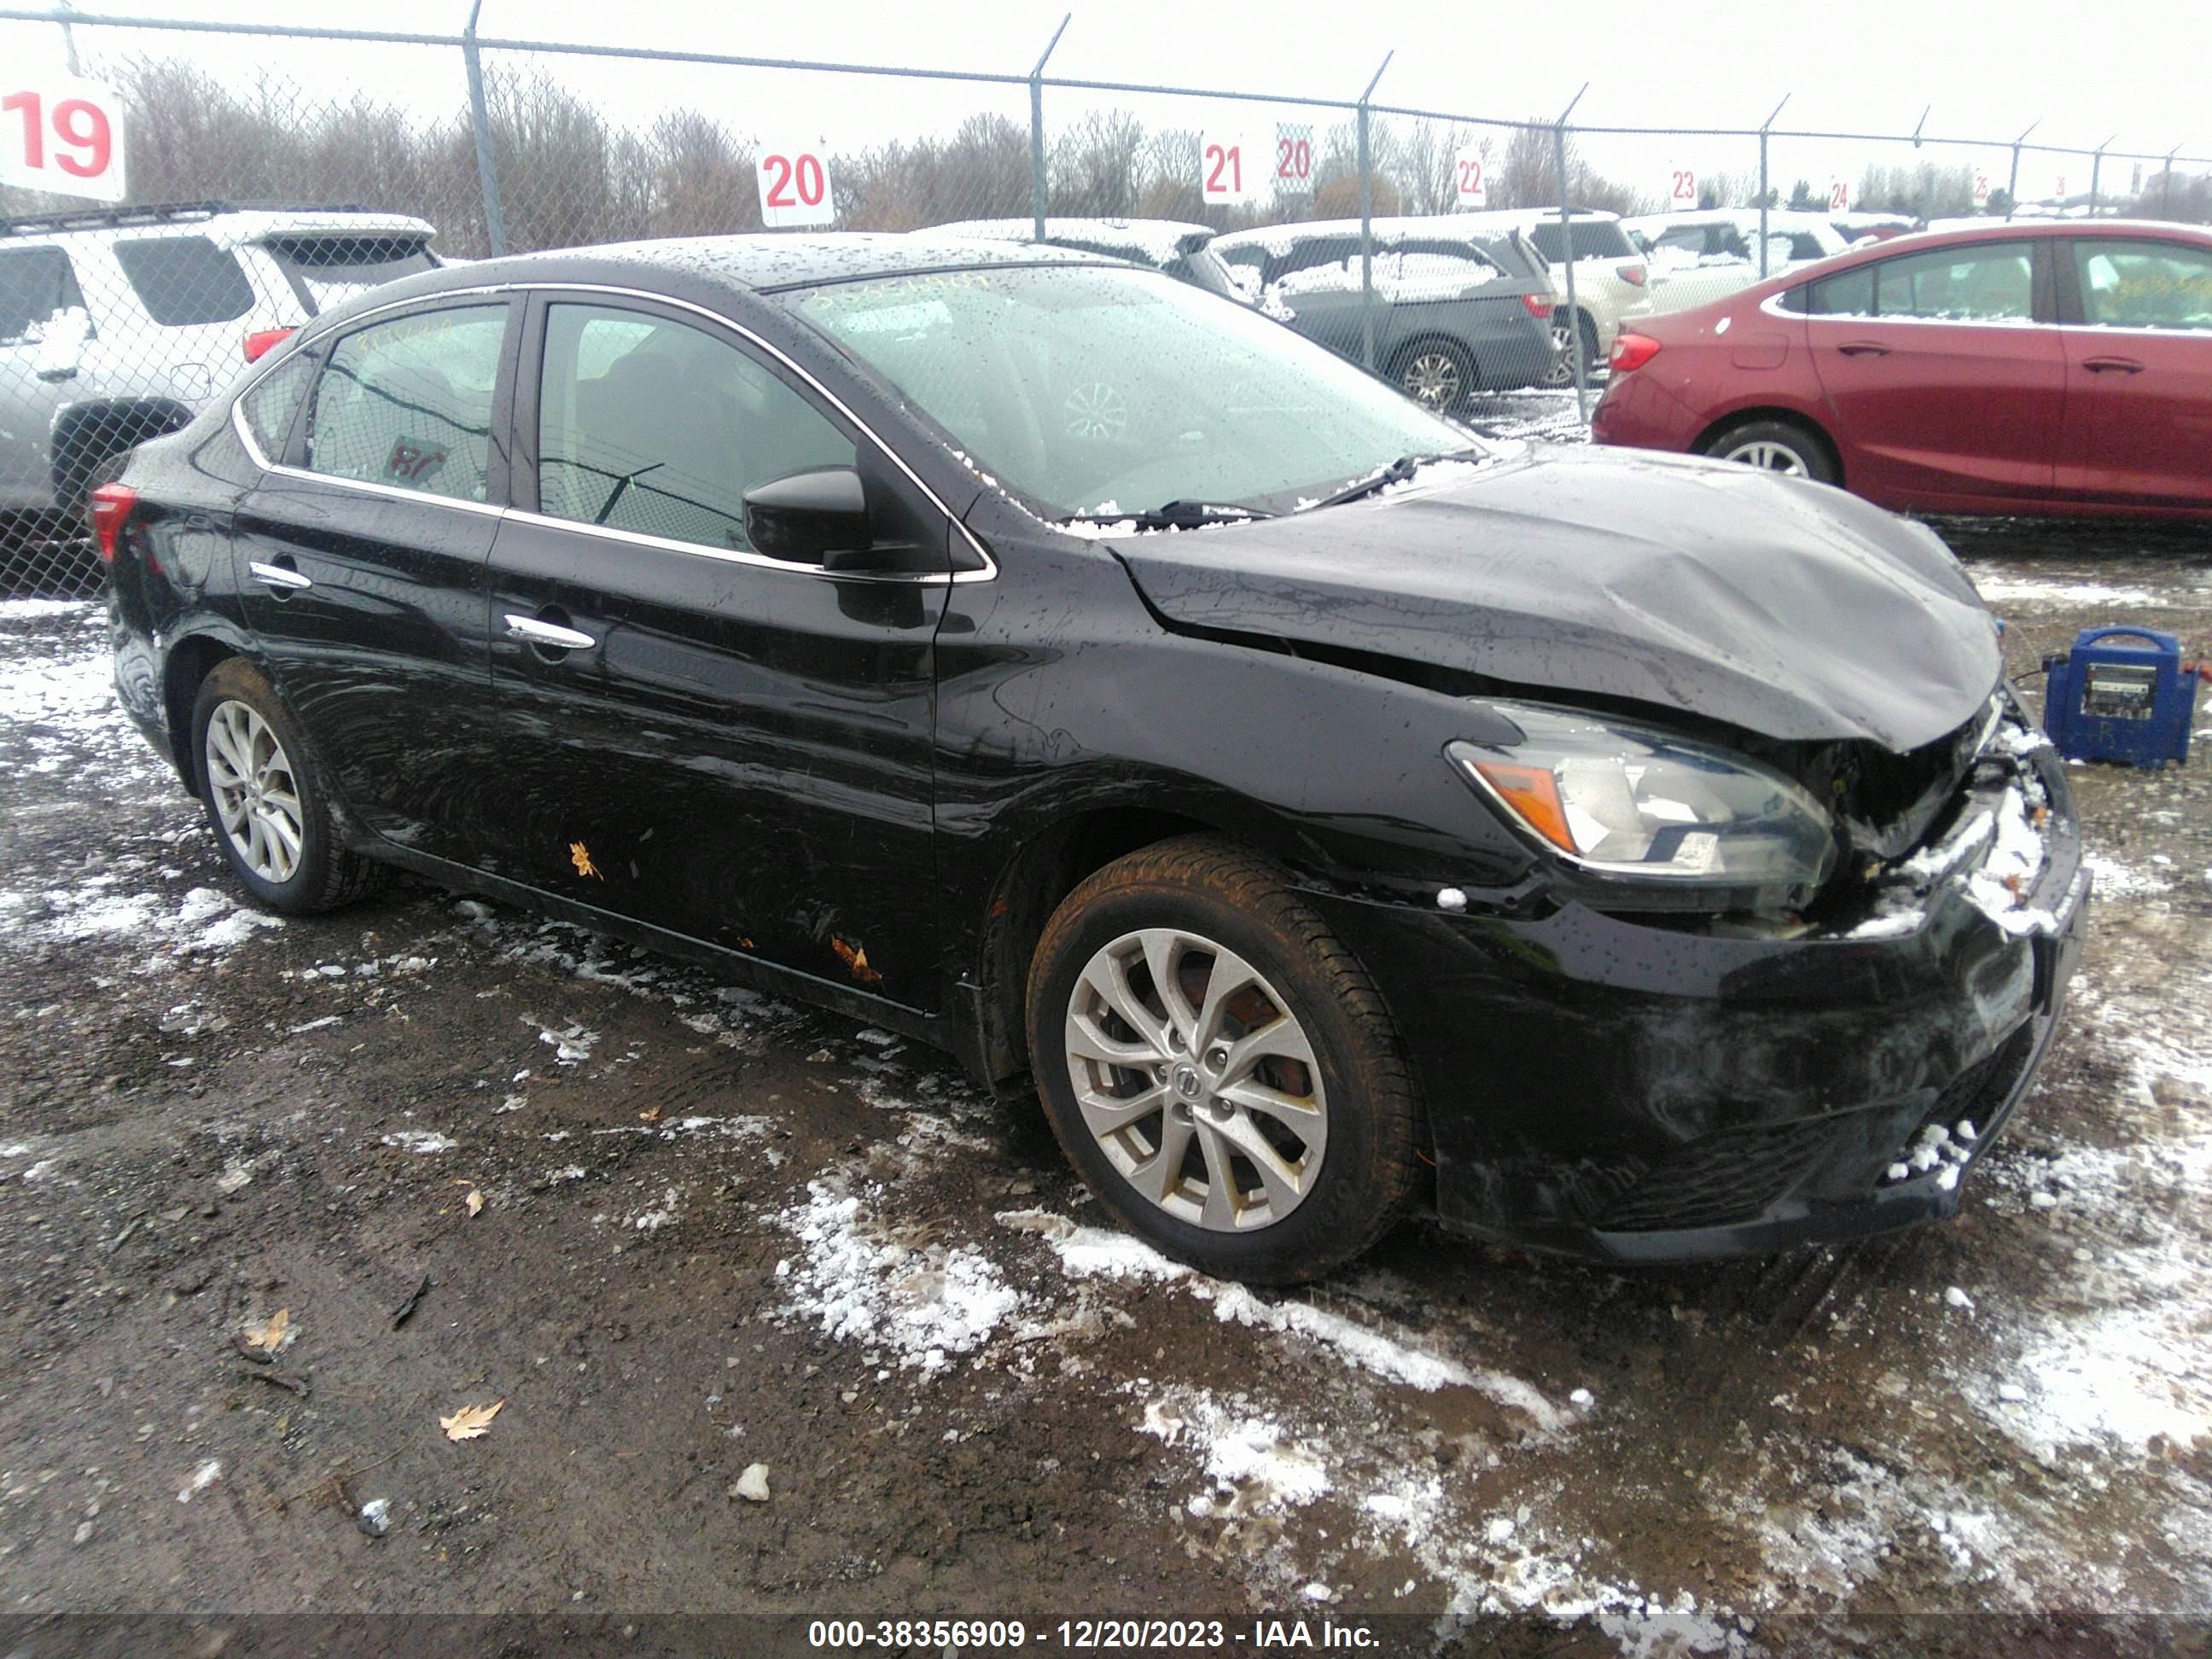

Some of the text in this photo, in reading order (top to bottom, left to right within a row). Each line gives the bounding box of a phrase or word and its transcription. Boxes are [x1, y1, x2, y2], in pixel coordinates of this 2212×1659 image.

[2, 90, 111, 178] 19
[1206, 144, 1241, 192] 21
[1278, 137, 1310, 178] 20
[1459, 160, 1481, 194] 22
[763, 154, 824, 207] 20
[1673, 171, 1694, 198] 23
[1831, 182, 1848, 209] 24
